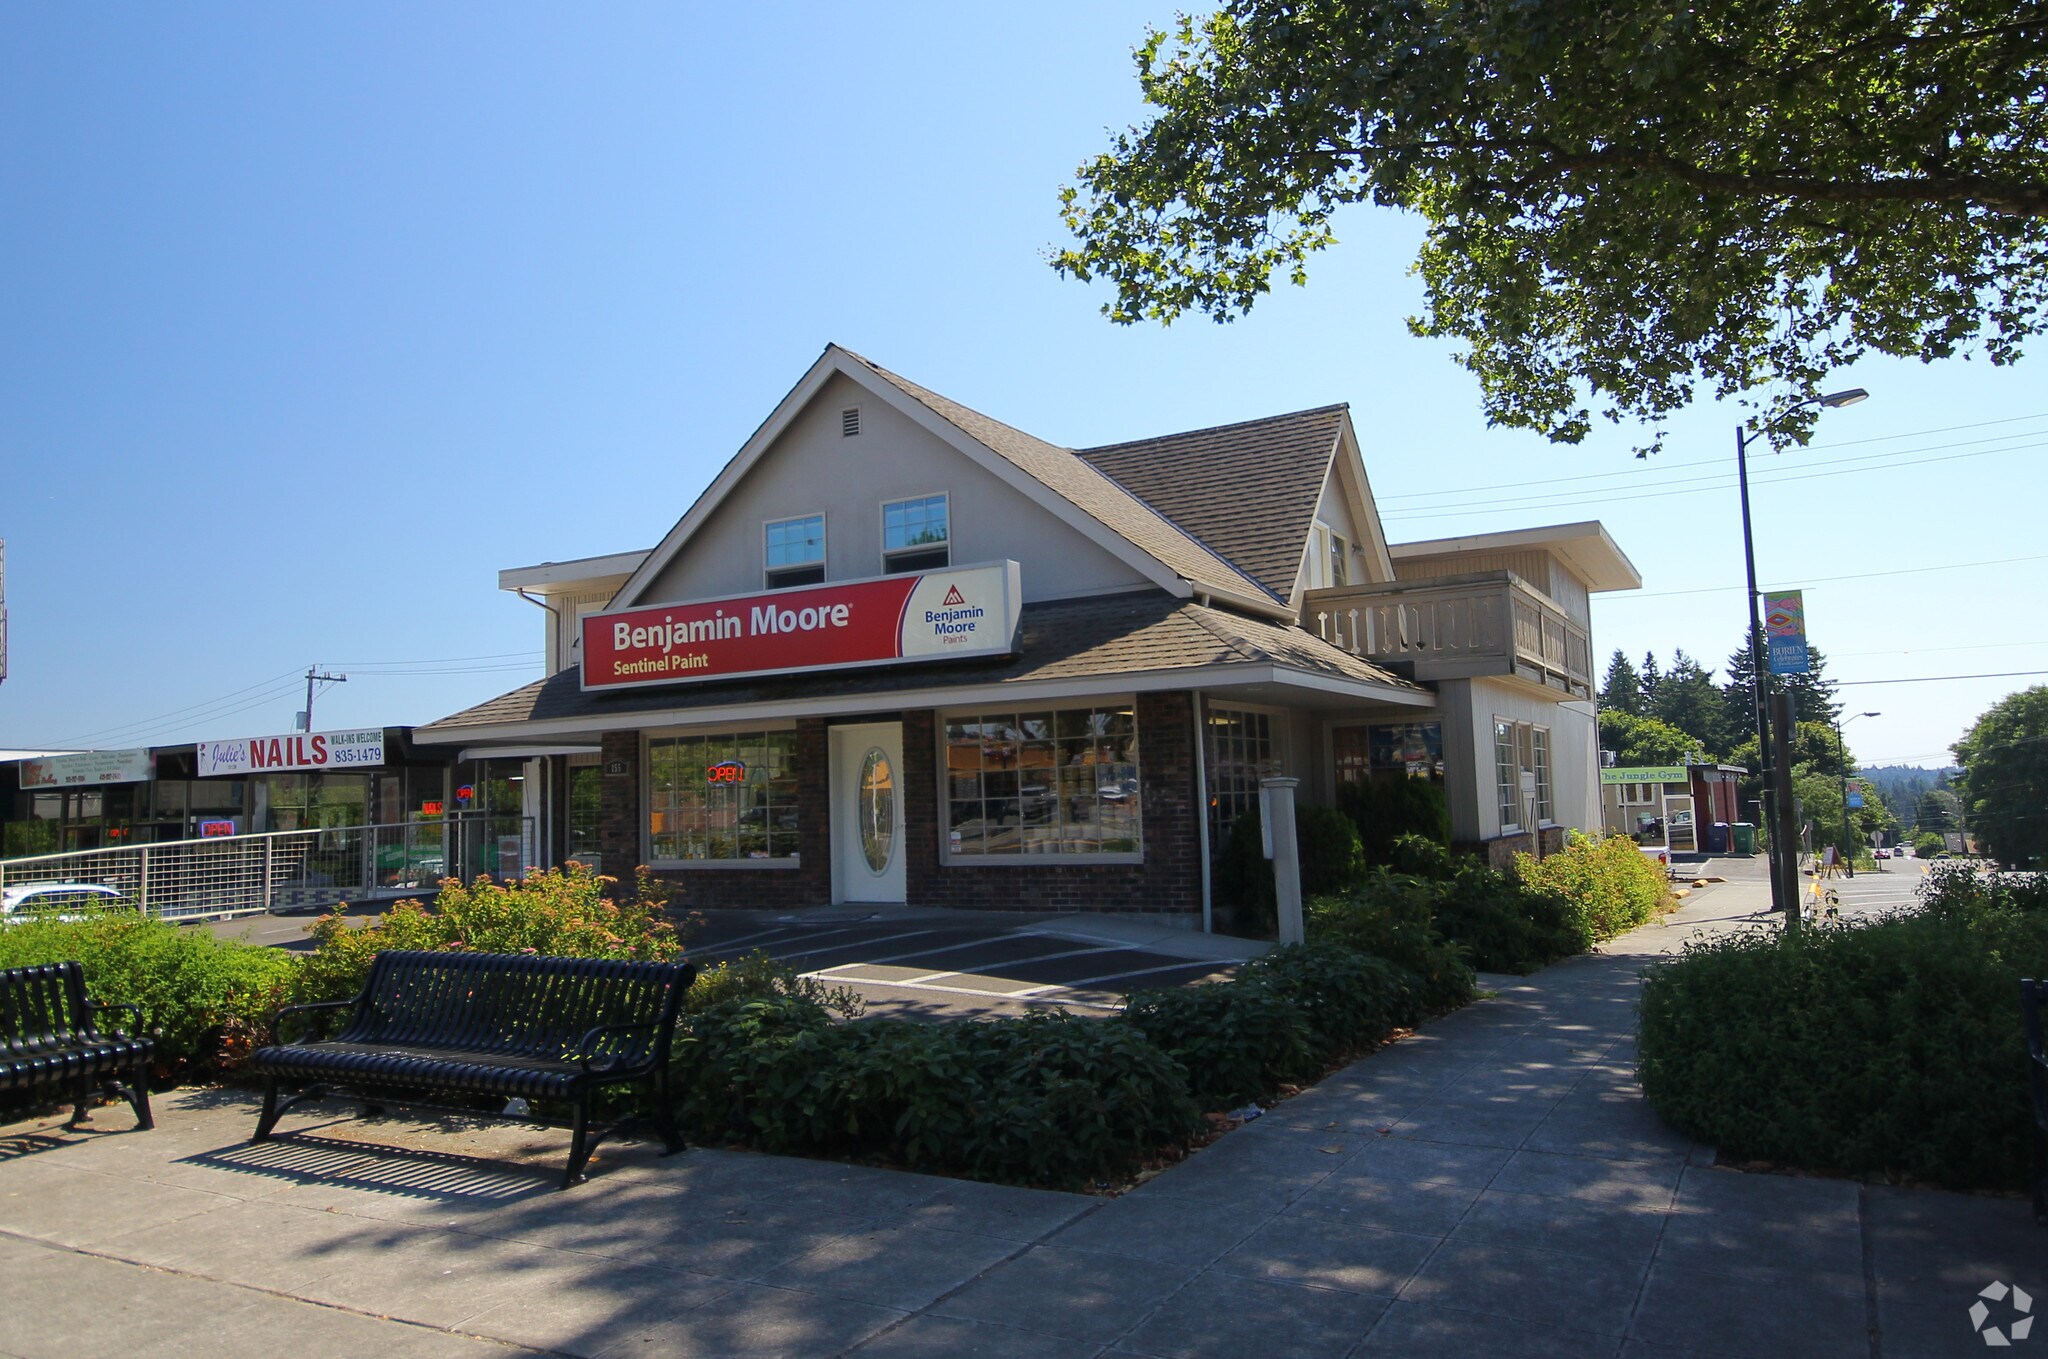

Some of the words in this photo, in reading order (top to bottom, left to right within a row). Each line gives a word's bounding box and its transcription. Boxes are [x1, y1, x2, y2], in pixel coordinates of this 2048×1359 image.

[925, 605, 984, 623] Benjamin
[613, 609, 742, 653] Benjamin
[750, 602, 849, 636] Moore
[934, 622, 976, 635] Moore
[943, 635, 968, 644] Paints
[1772, 645, 1803, 656] BURIEN
[613, 655, 669, 675] Sentinel
[671, 653, 708, 670] Paint
[330, 733, 355, 745] WALK-INS
[356, 732, 382, 743] WELCOME
[212, 743, 247, 772] Julie's
[250, 735, 328, 768] NAILS
[335, 747, 381, 763] 835-1479
[707, 766, 744, 781] OPEN
[1619, 772, 1655, 780] Jungle
[1658, 770, 1683, 779] Gym
[423, 801, 443, 815] NAILS
[203, 822, 232, 836] OPEN
